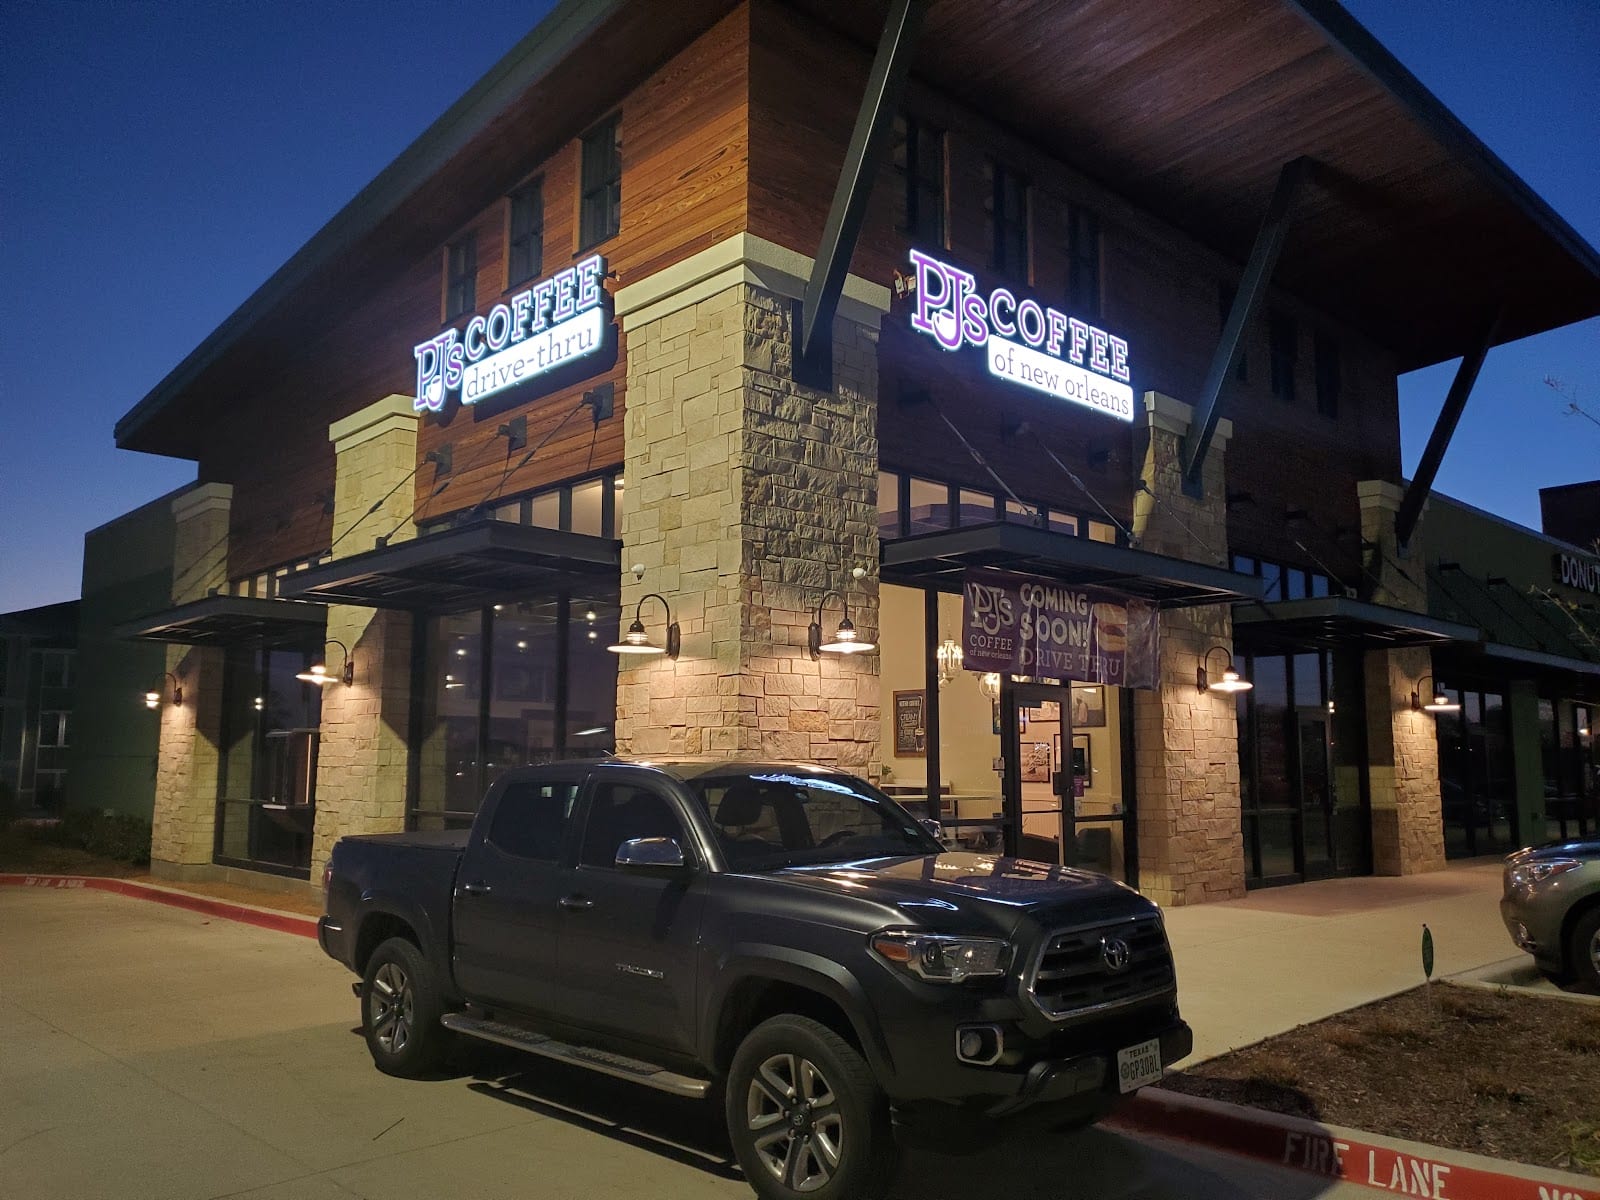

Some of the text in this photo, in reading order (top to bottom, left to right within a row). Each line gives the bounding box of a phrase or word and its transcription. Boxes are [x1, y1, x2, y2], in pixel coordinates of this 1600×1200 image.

[414, 254, 602, 411] PJ's COFFEE
[910, 249, 1130, 382] PJ's COFFEE
[466, 327, 594, 399] drive-thru
[994, 347, 1130, 416] of new orleans
[969, 582, 1016, 636] PJ's
[1020, 583, 1088, 616] COMING
[969, 634, 1013, 651] COFFEE
[1020, 612, 1089, 648] SOON!
[1019, 646, 1121, 676] DRIVE THRU
[1129, 1045, 1149, 1059] TEXAS
[1283, 1130, 1451, 1200] FIRE LANE
